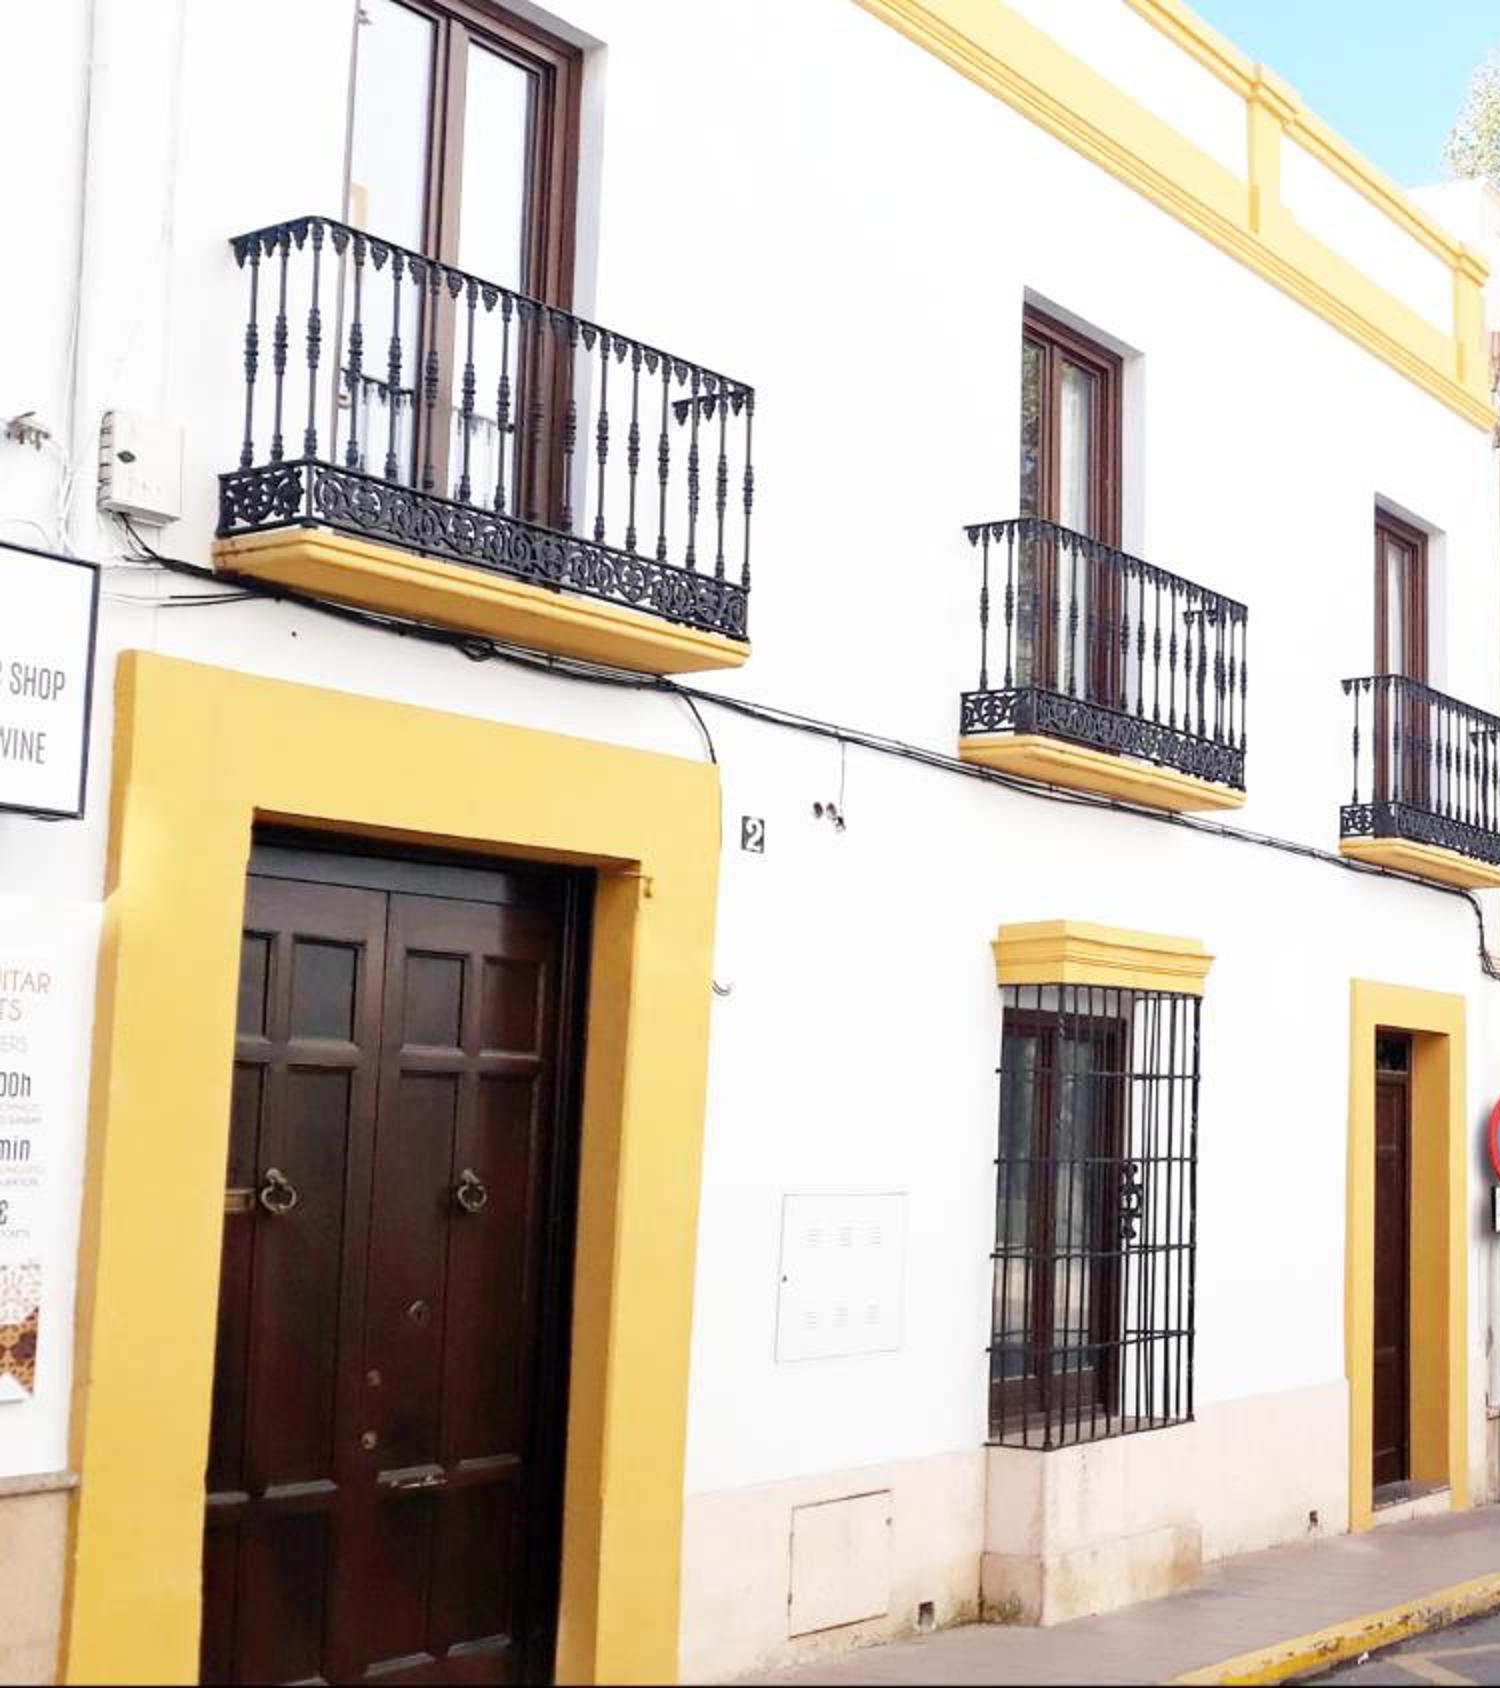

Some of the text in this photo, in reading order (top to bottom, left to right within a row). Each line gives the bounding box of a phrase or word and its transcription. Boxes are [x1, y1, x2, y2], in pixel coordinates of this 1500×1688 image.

[8, 662, 65, 701] SHOP
[745, 818, 763, 852] 2
[0, 969, 51, 994] ITAR
